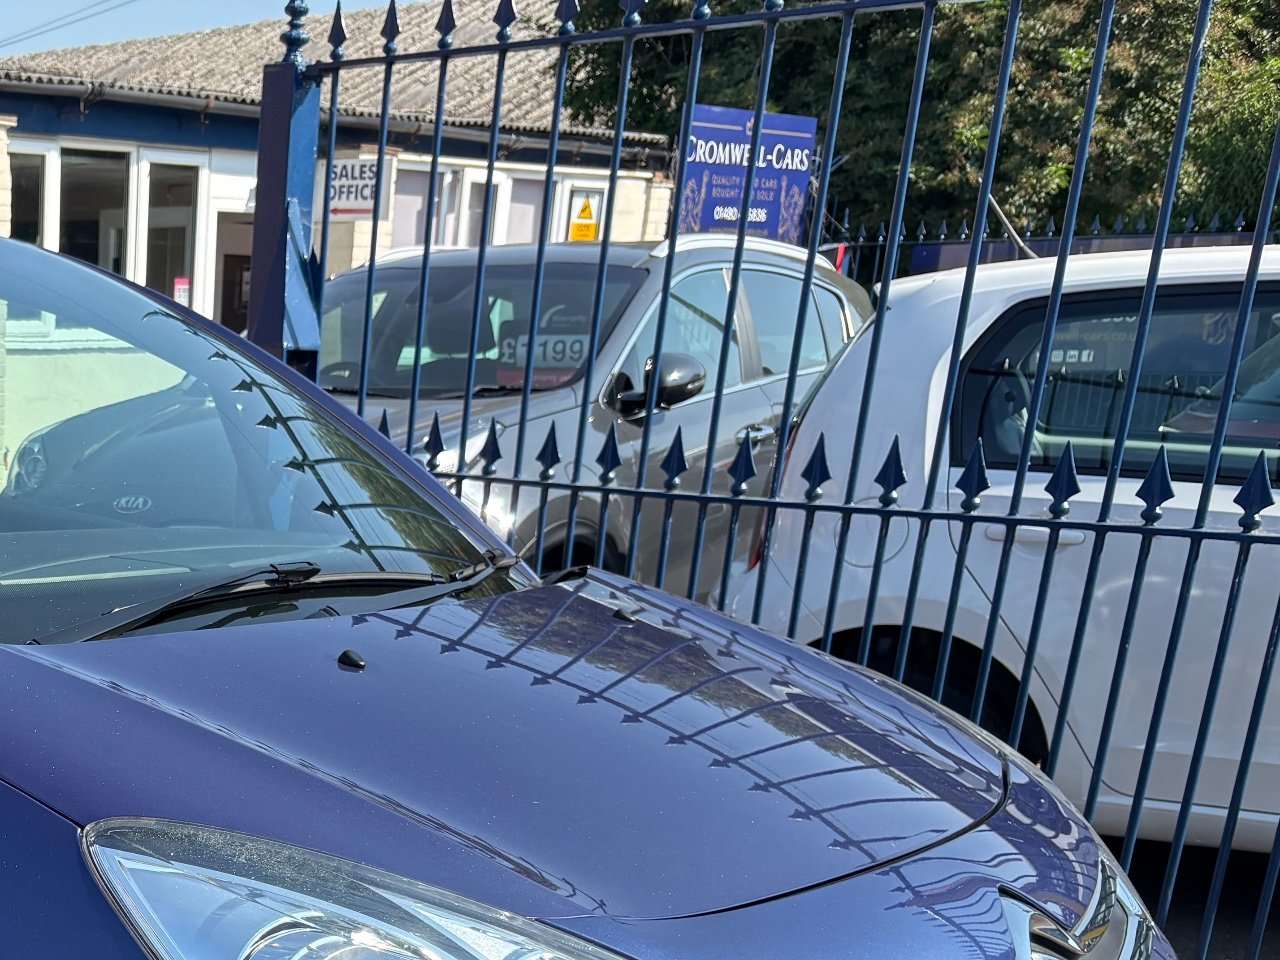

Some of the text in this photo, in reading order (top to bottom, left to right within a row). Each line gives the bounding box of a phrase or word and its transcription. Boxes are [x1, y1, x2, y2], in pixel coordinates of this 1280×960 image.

[687, 135, 810, 171] CROMWEL-CARS
[331, 164, 377, 181] SALES
[119, 496, 145, 509] KIA
